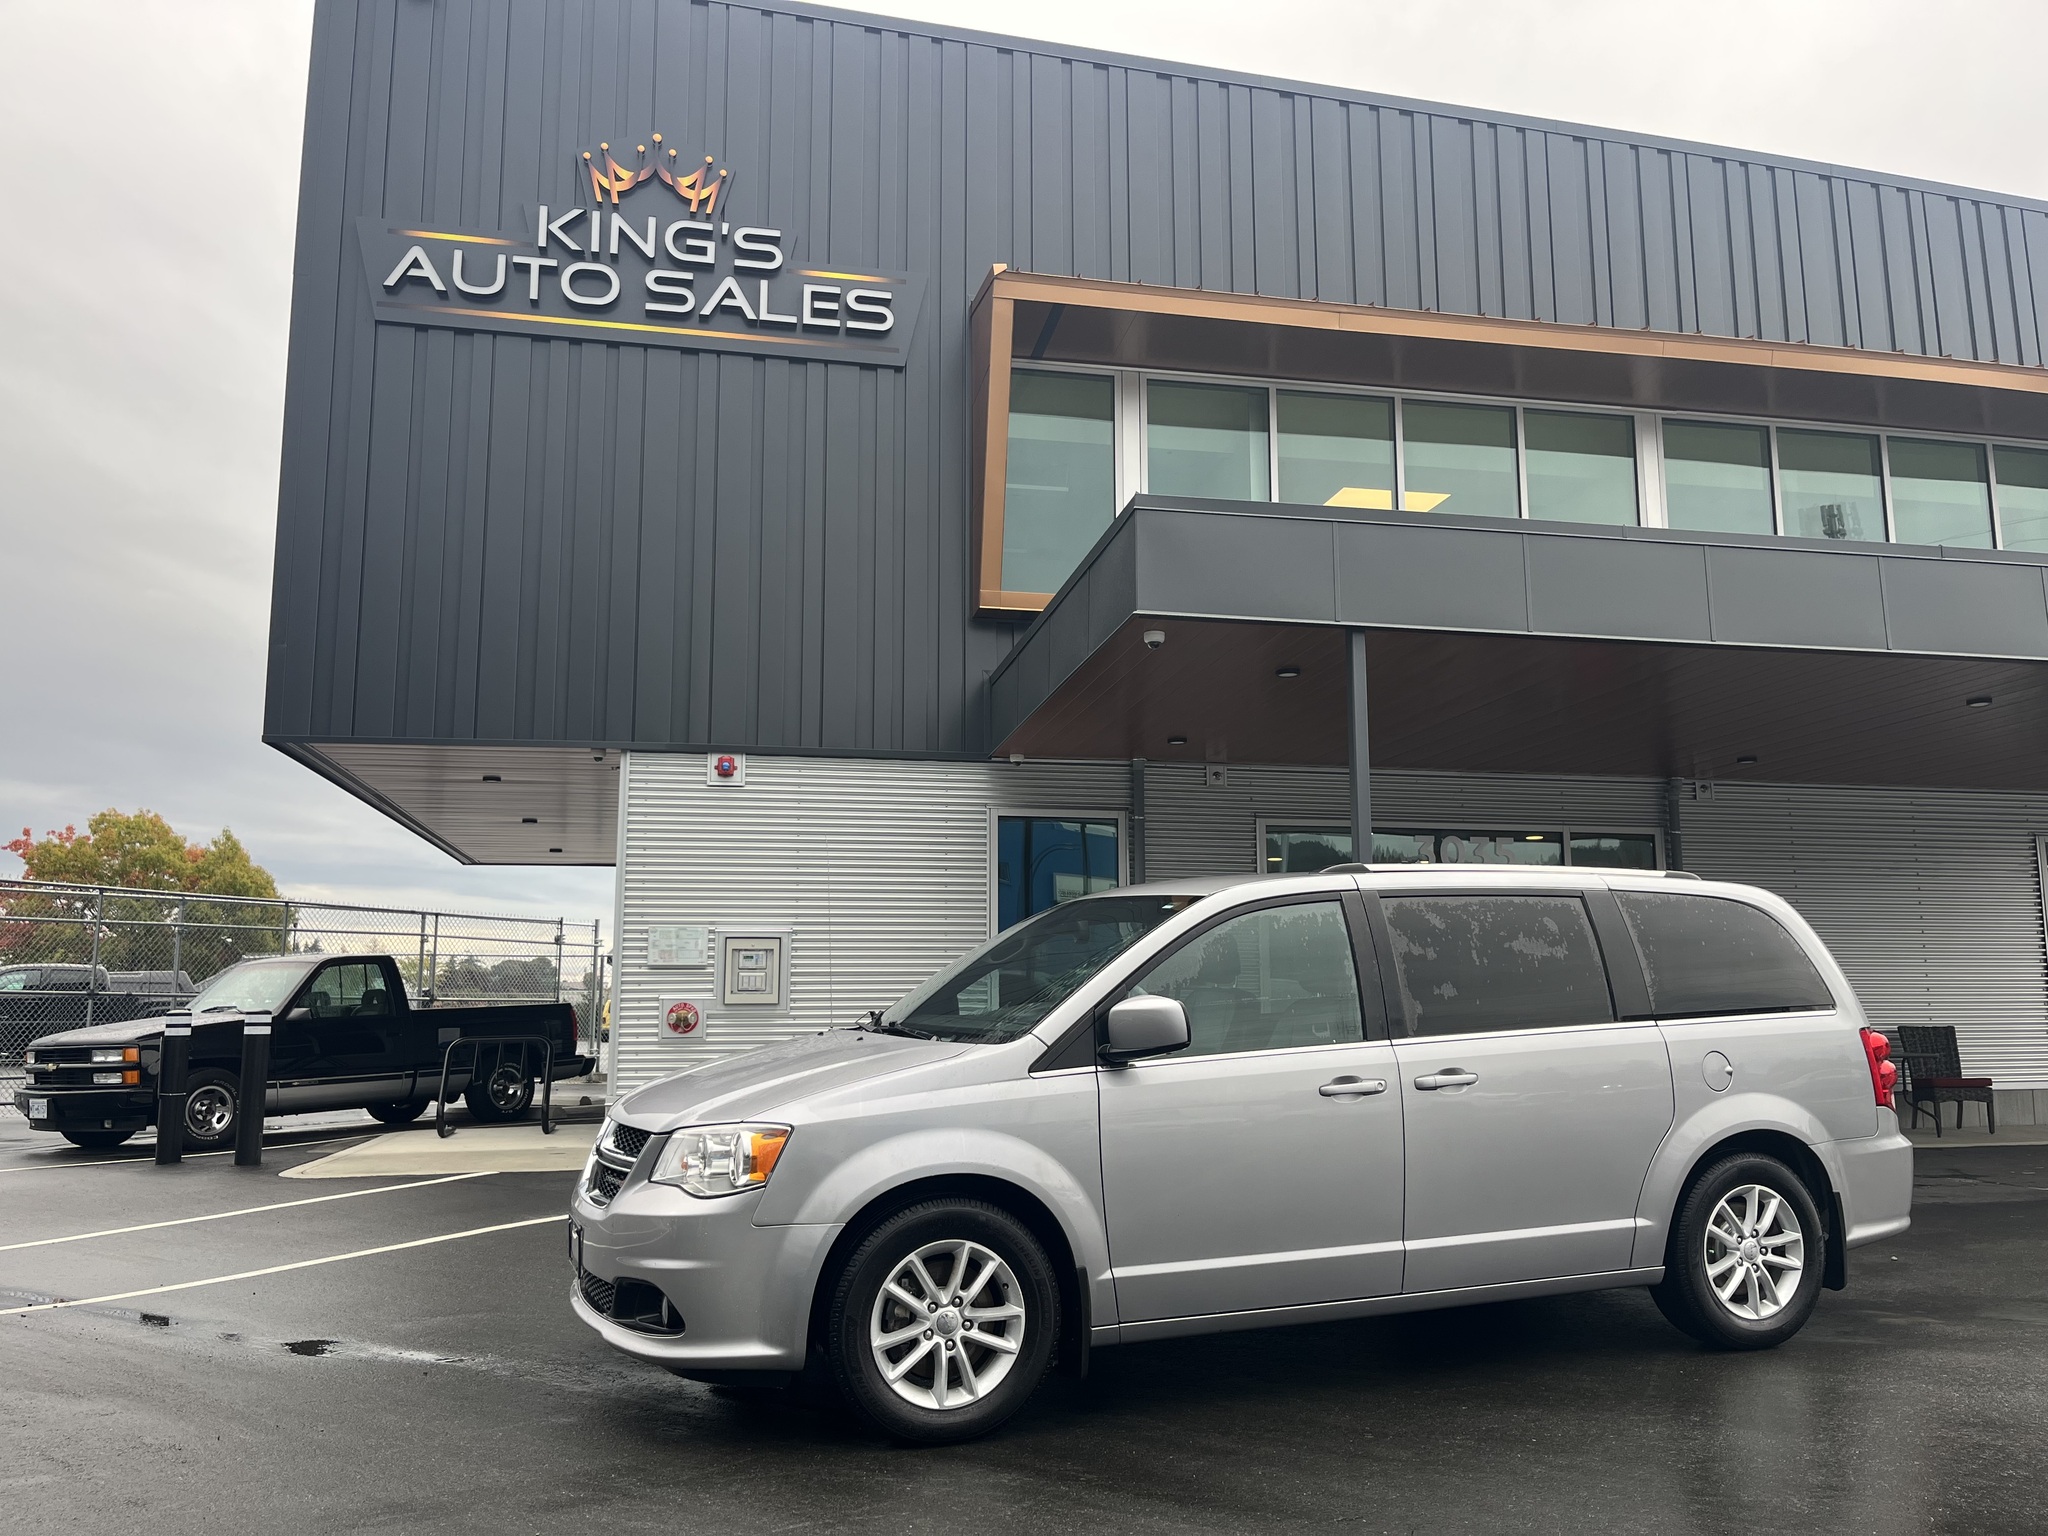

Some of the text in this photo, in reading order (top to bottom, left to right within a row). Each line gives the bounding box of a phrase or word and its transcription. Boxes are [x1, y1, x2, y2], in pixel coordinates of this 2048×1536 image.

[537, 204, 785, 271] KING'S
[382, 244, 896, 332] AUTO SALES
[1415, 835, 1515, 864] 3035
